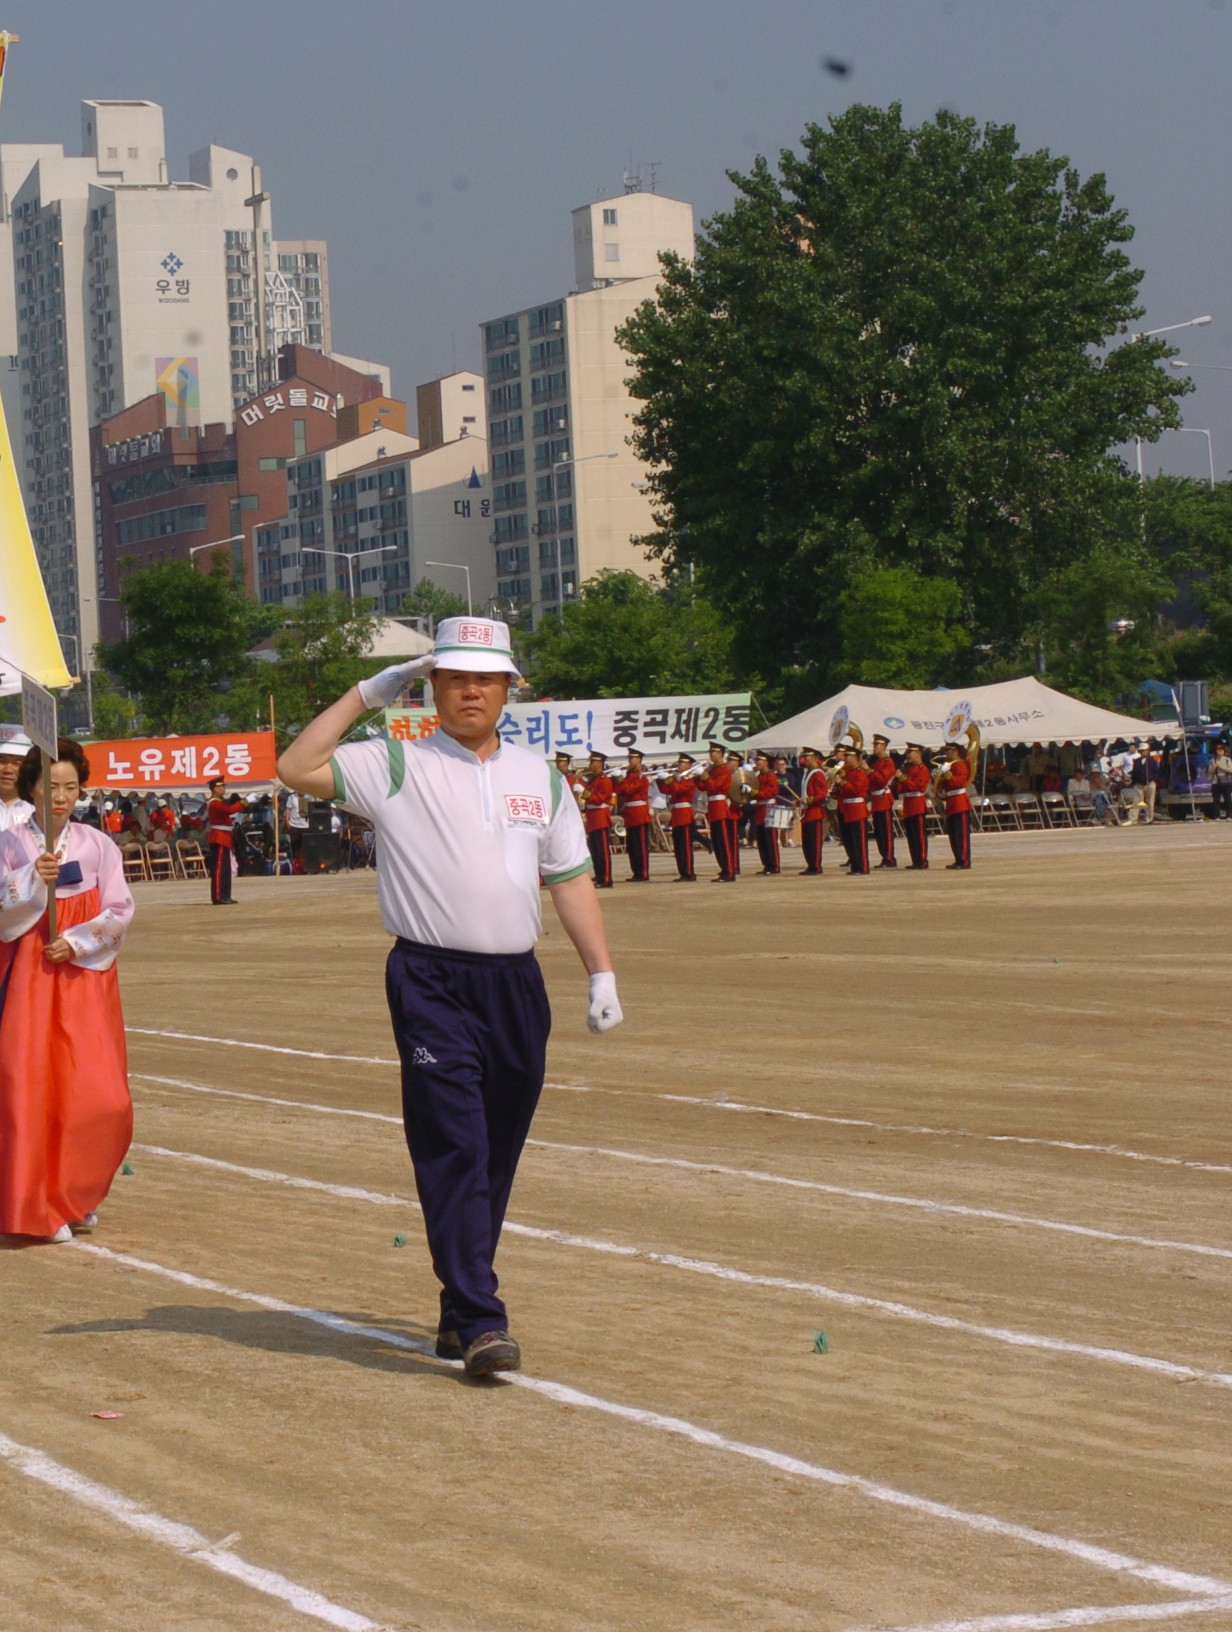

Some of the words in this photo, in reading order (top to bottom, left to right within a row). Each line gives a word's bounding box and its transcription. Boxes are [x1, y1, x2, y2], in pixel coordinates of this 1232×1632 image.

[155, 279, 190, 296] 우방
[461, 625, 491, 643] 중곡2동
[612, 704, 750, 748] 중곡제2동
[106, 743, 253, 782] 노유제2동
[509, 798, 543, 818] 중곡2동
